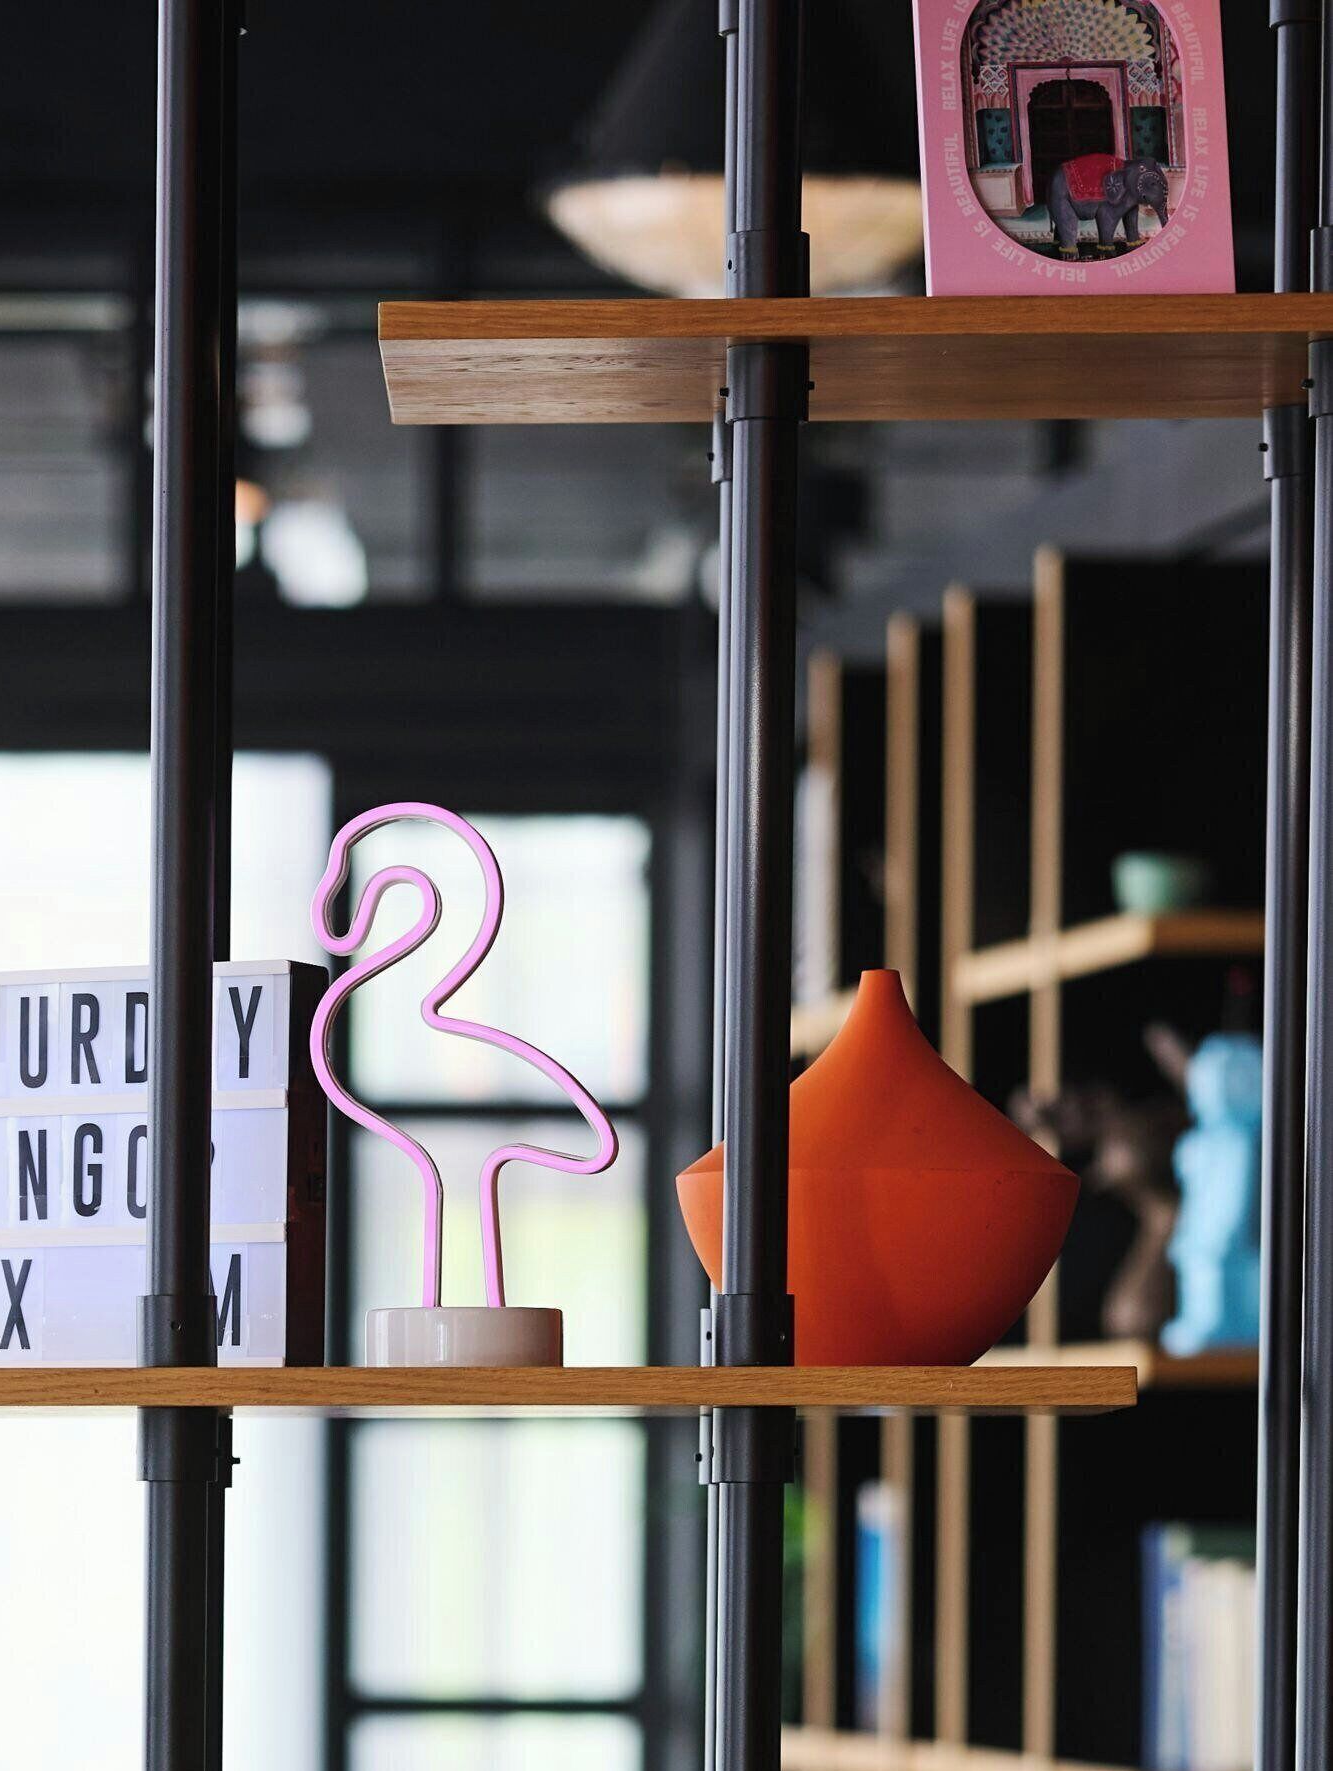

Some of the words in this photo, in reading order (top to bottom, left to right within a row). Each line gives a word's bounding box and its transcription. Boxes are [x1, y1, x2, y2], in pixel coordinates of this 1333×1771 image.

[941, 18, 959, 51] LIFE
[1171, 3, 1204, 85] BEAUTIFUL
[941, 61, 956, 110] RELAX
[1192, 107, 1209, 155] RELAX
[944, 133, 976, 217] BEAUTIFUL
[1190, 165, 1209, 200] LIFE
[974, 220, 992, 238] IS
[1183, 204, 1200, 222] IS
[992, 238, 1026, 266] LIFE
[1109, 223, 1187, 278] BEAUTIFUL
[1032, 260, 1086, 282] RELAX
